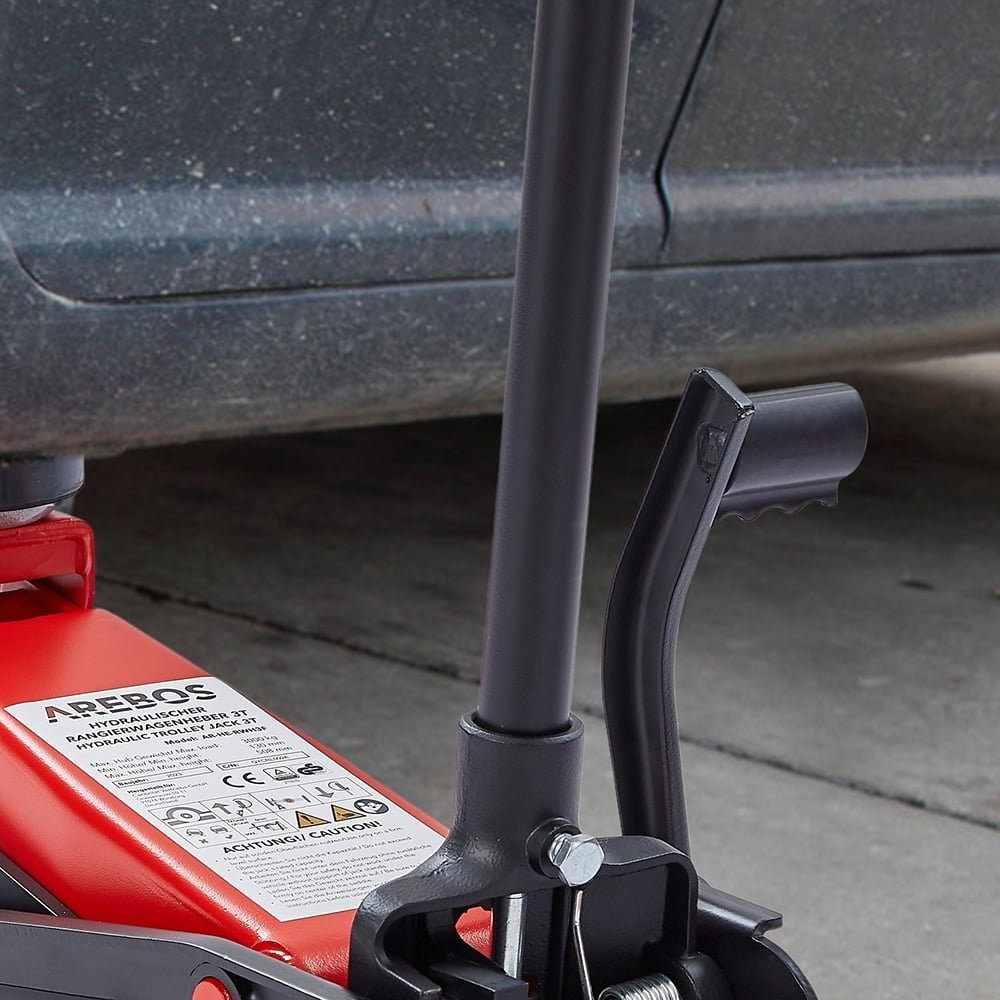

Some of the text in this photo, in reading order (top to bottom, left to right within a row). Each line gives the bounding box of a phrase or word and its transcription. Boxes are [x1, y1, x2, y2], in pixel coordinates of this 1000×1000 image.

[45, 684, 216, 723] AREBOS
[89, 707, 207, 729] HYDRAULISCHER
[66, 713, 229, 742] RANGIERWAGENHEBER
[76, 734, 150, 750] HYDRAULIC
[150, 725, 204, 737] TROLLEY
[210, 720, 241, 729] JACK
[164, 737, 199, 745] Model:
[223, 821, 382, 853] ACHTUNG!/ CAUTION!
